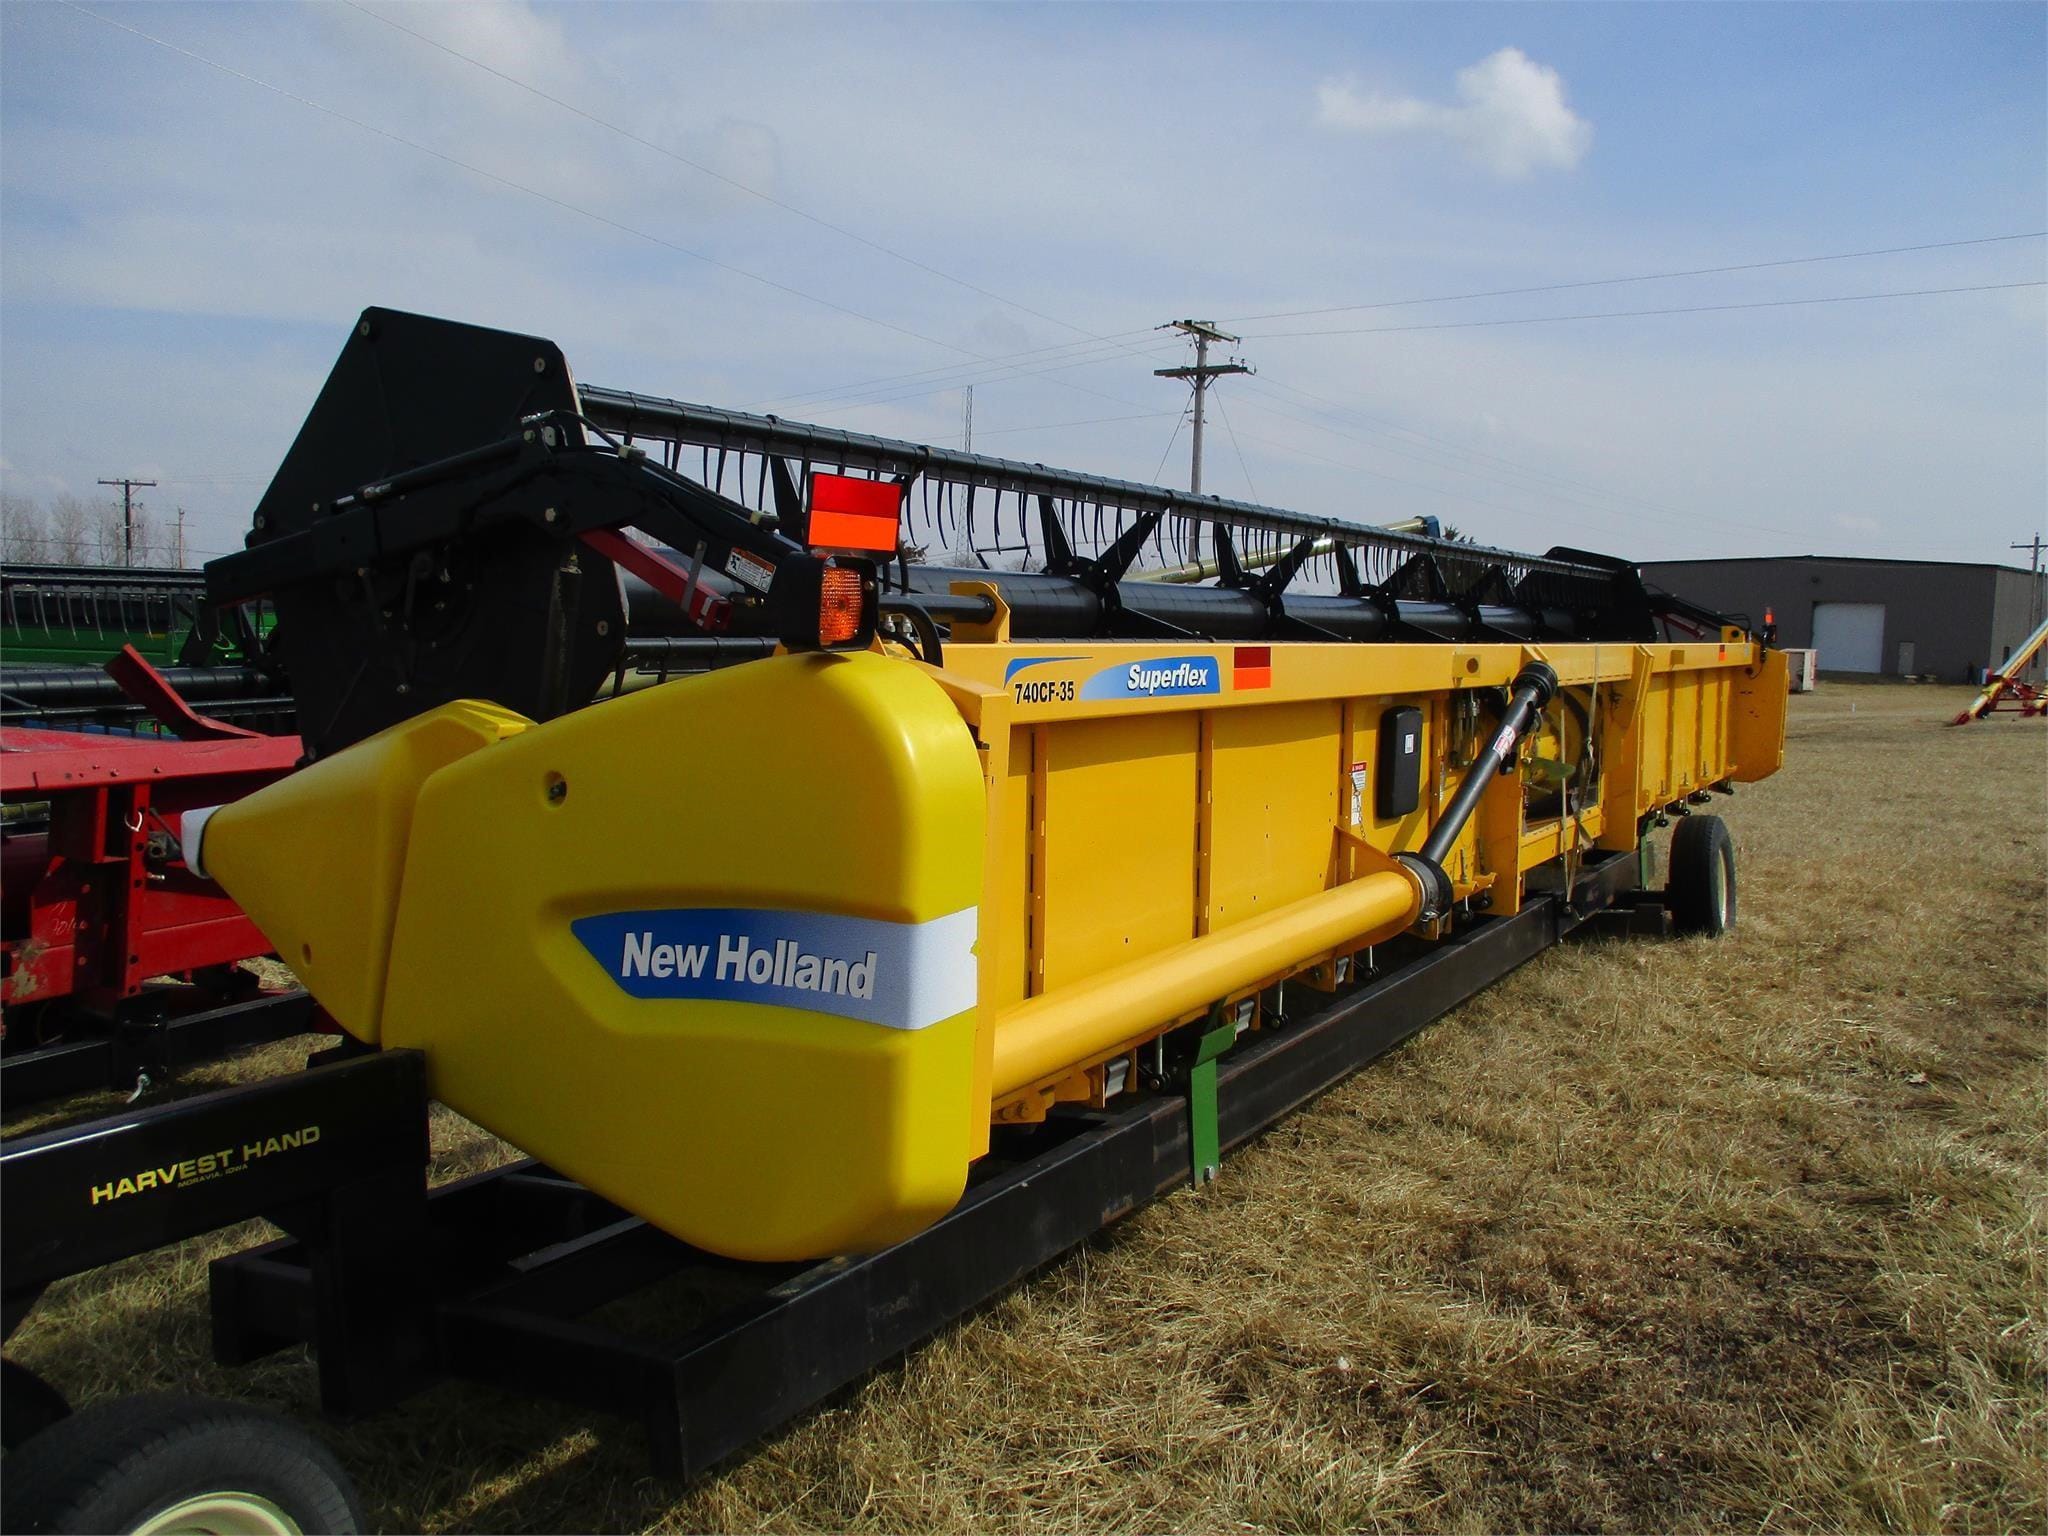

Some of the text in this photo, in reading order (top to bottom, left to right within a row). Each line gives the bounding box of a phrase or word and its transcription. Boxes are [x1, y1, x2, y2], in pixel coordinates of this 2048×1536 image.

[1015, 681, 1074, 704] 740CF-35
[1127, 663, 1208, 694] Superflex
[621, 932, 878, 1000] New Holland
[92, 1126, 320, 1205] HARVEST HAND
